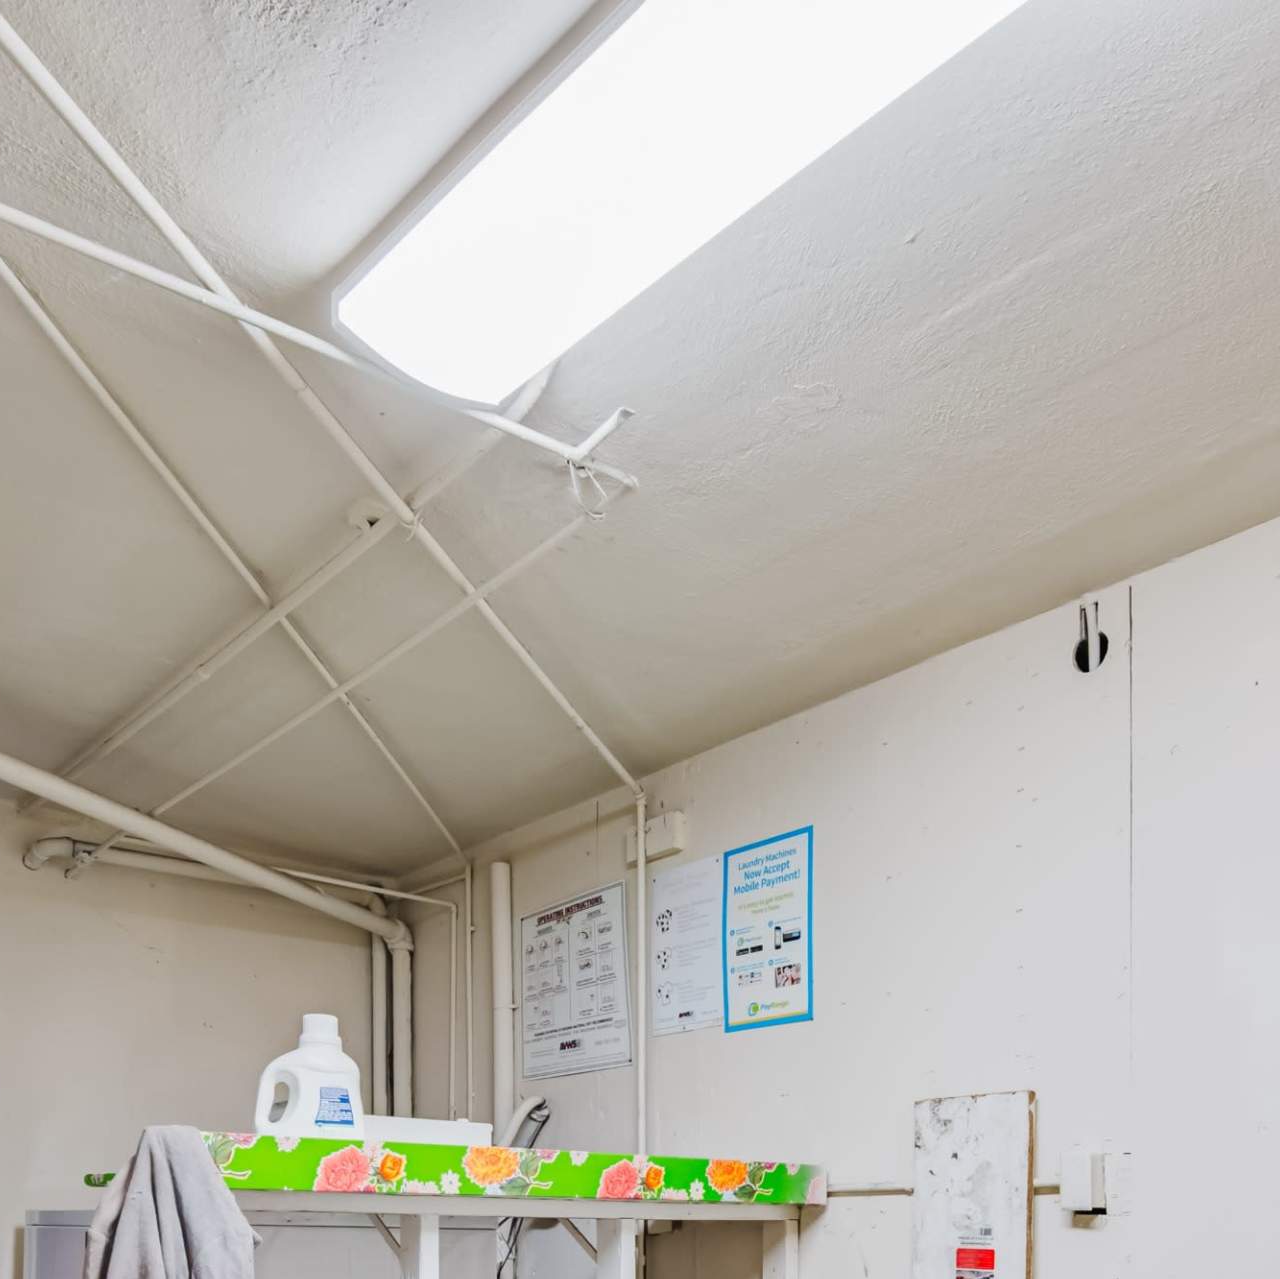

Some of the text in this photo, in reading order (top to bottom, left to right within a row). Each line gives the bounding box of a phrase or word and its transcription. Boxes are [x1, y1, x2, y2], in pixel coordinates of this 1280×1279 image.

[738, 847, 797, 872] Laundry Machines
[744, 860, 790, 880] Now Accept
[734, 869, 800, 896] Mobile Payment!
